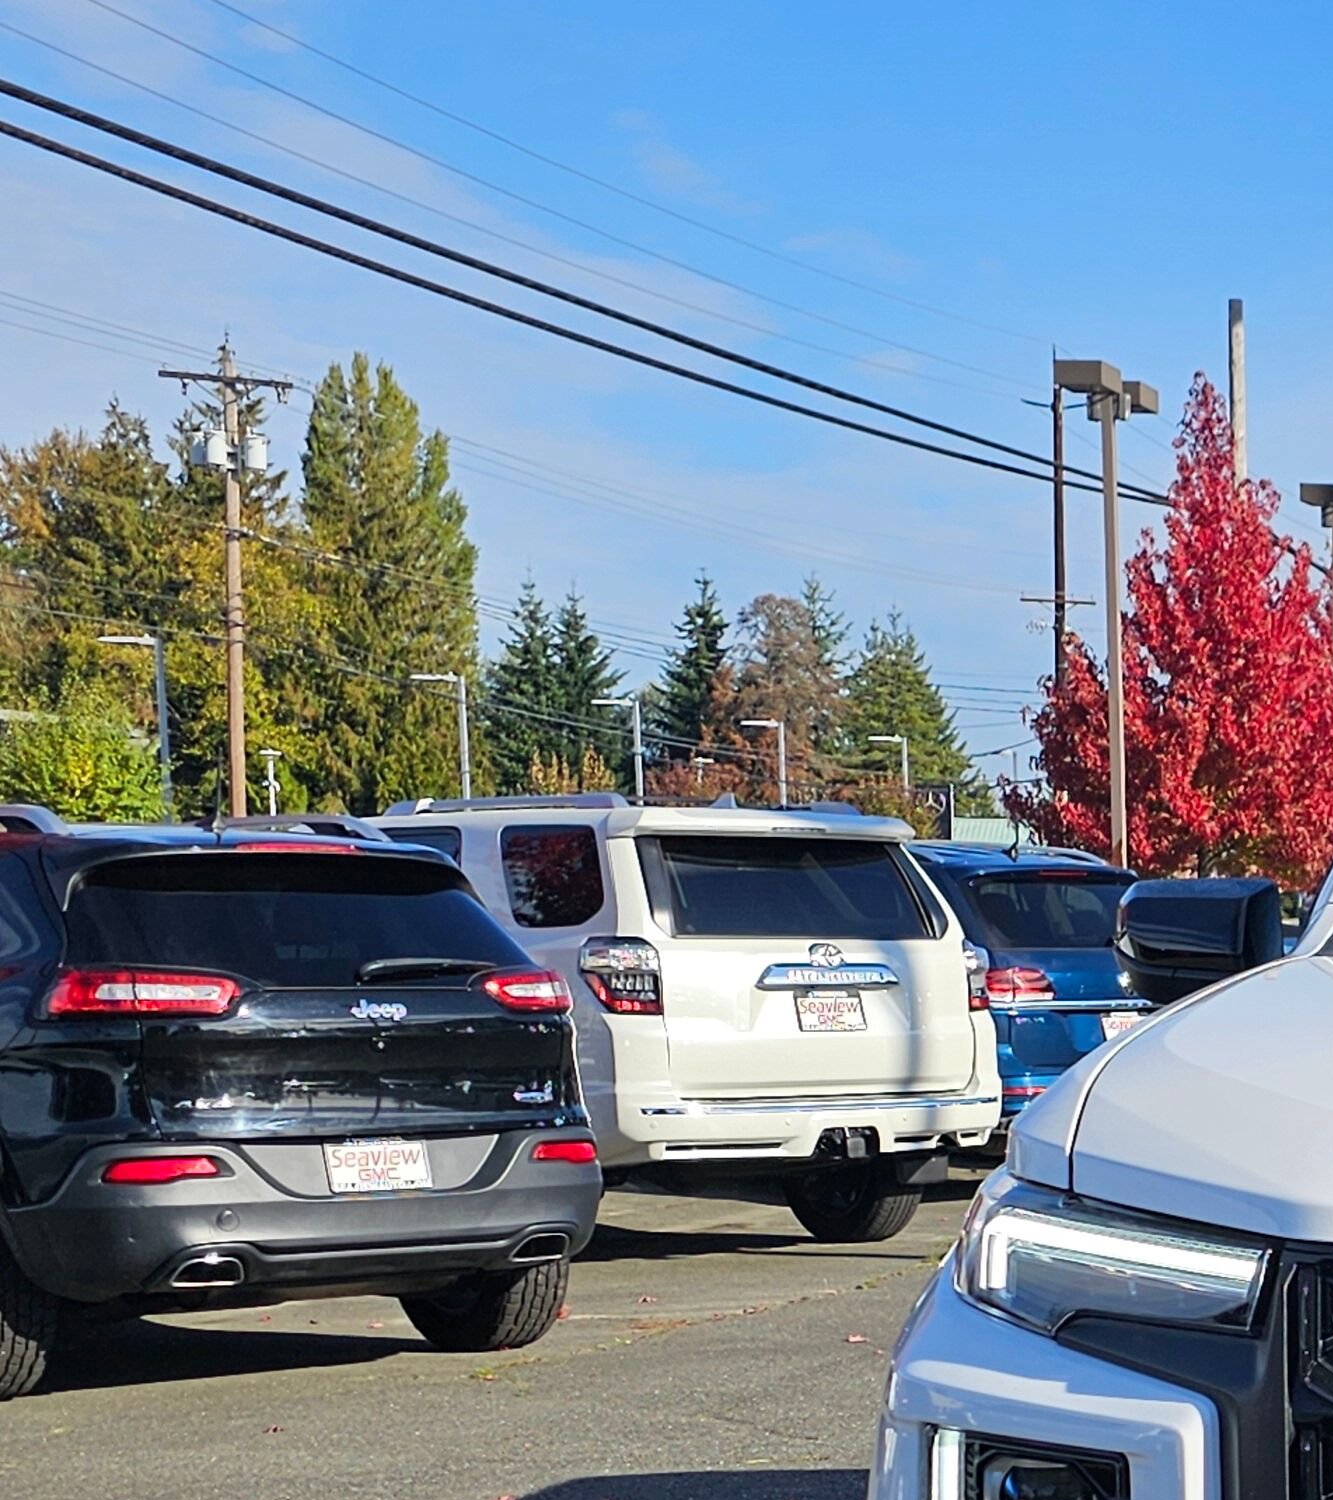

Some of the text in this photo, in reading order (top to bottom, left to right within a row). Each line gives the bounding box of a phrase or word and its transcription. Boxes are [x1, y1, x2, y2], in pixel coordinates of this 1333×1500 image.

[350, 998, 408, 1022] Jeep
[799, 997, 861, 1015] Seaview
[331, 1147, 421, 1169] Seaview
[358, 1167, 402, 1182] GMC
